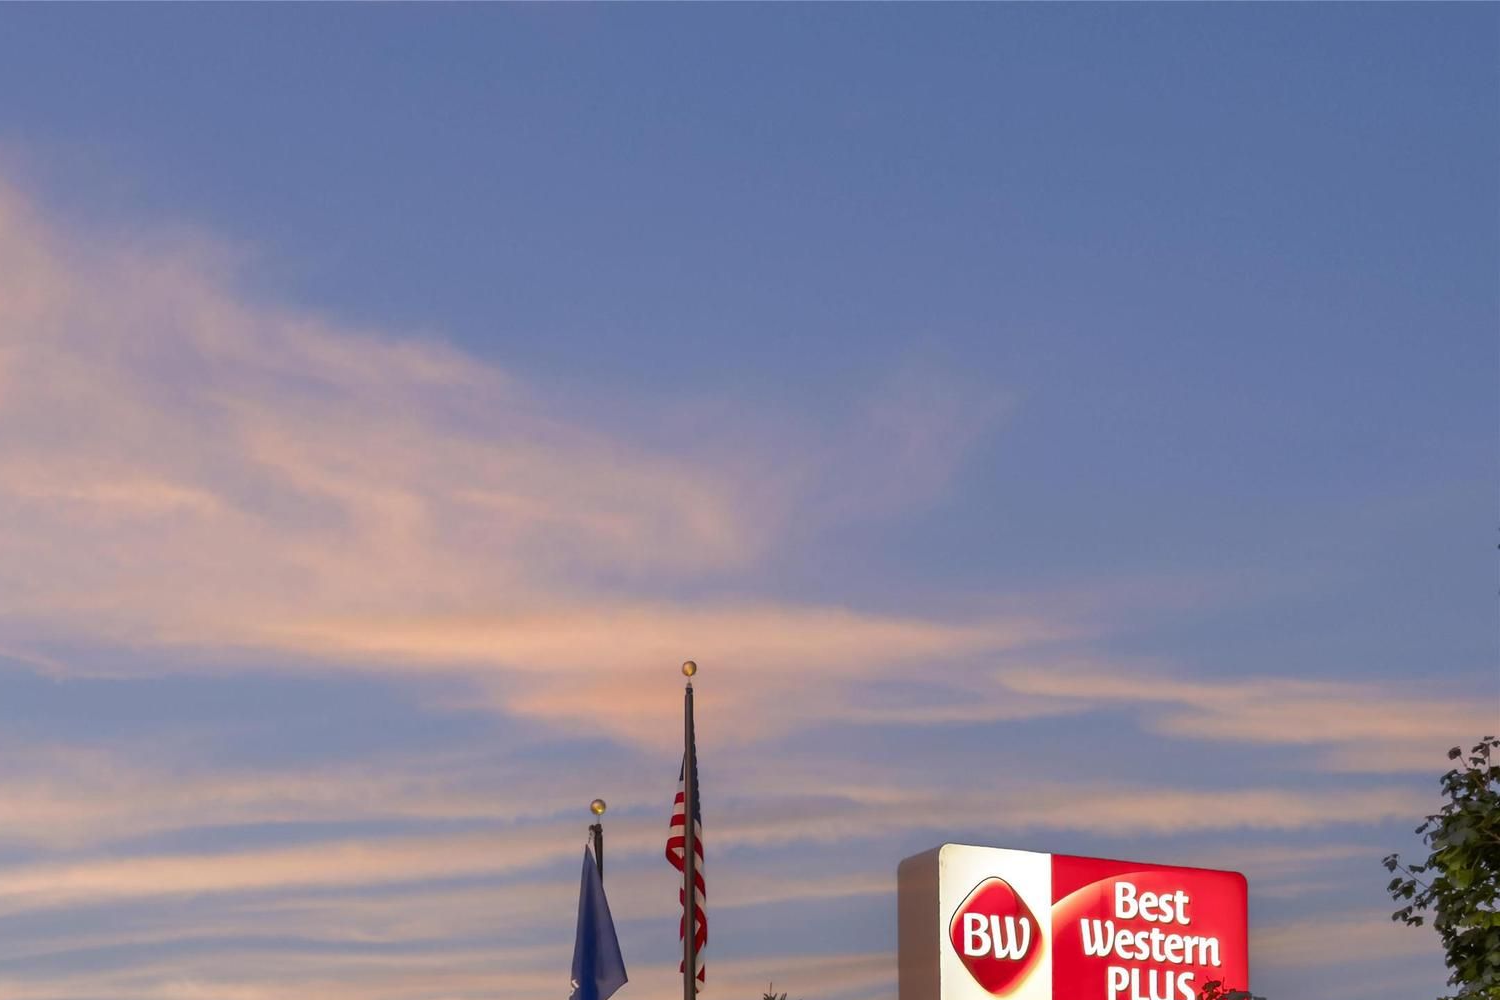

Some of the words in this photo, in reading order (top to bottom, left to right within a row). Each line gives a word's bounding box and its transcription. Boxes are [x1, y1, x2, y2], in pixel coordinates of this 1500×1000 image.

[1114, 881, 1190, 925] Best
[962, 912, 1031, 961] BW
[1080, 918, 1221, 967] Western
